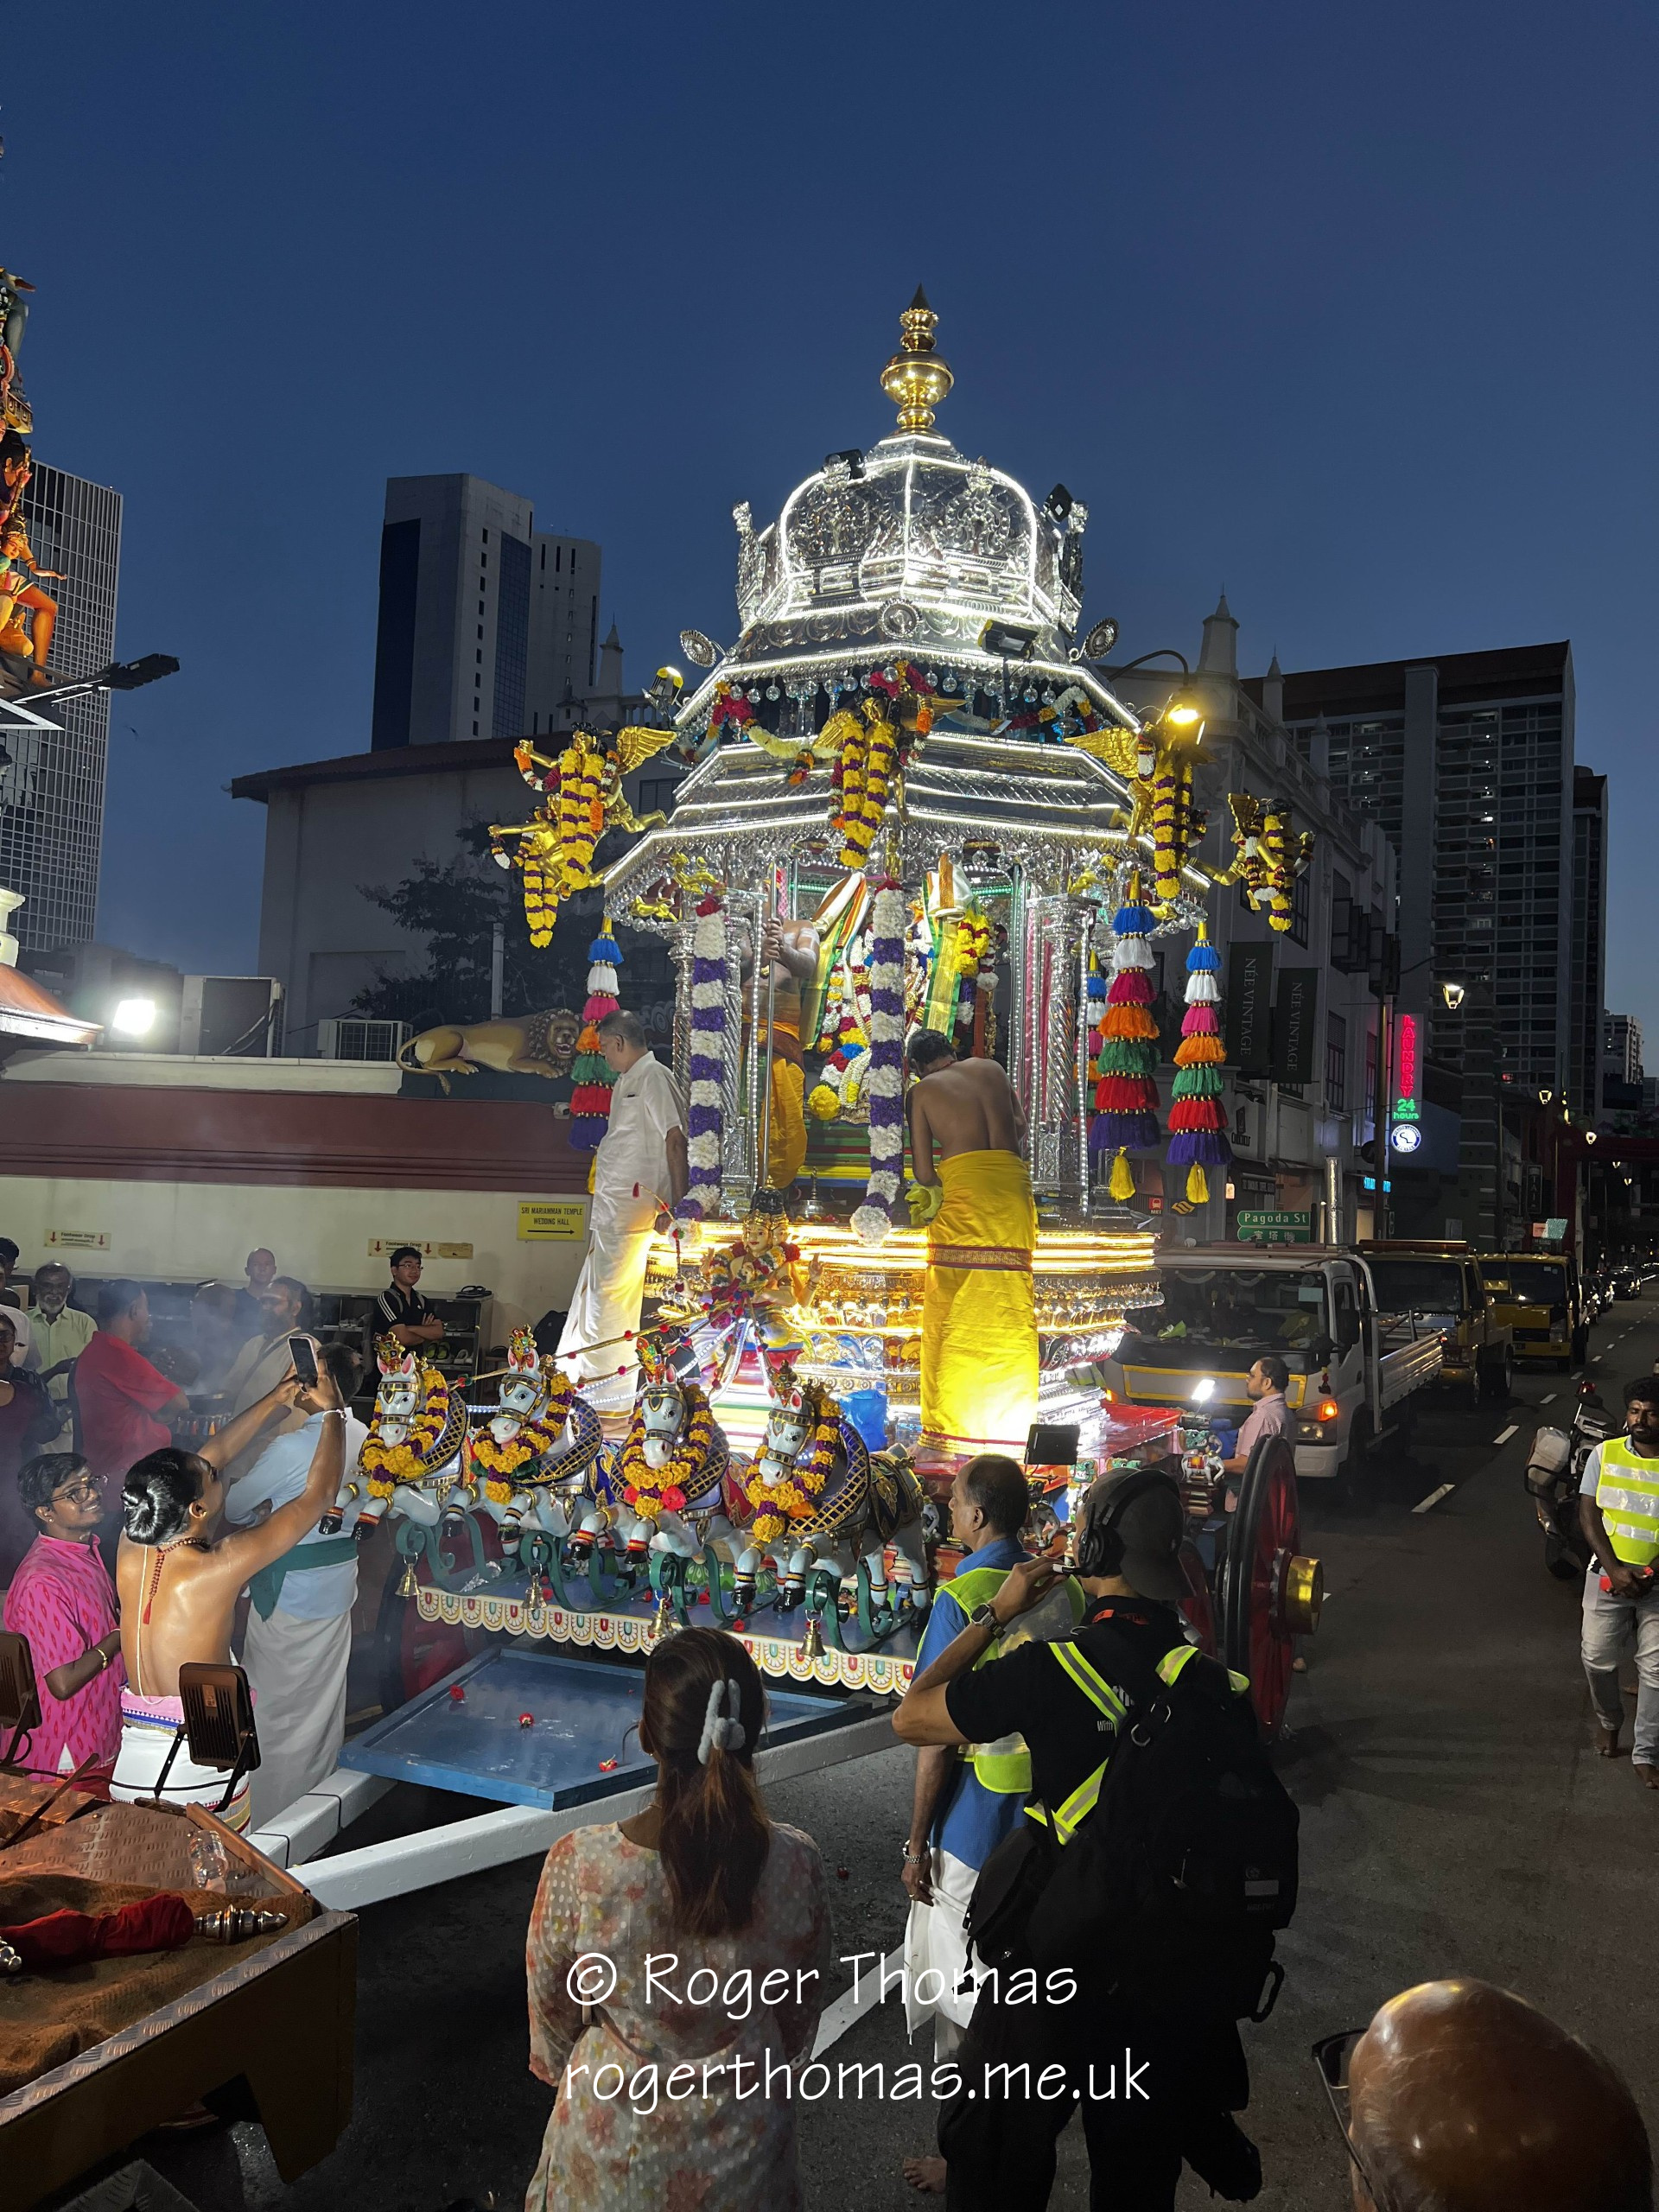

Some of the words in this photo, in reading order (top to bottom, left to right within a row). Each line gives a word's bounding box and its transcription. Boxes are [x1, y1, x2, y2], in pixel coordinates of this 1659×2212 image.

[1243, 957, 1259, 988] NÉE
[1240, 989, 1255, 1056] VINTAGE
[1287, 1011, 1300, 1071] VINTAGE
[1400, 1014, 1415, 1097] LAUNDRY
[1393, 1111, 1420, 1120] hours
[1397, 1098, 1415, 1112] 24
[1244, 1212, 1289, 1225] Pagoda
[1294, 1212, 1306, 1224] St
